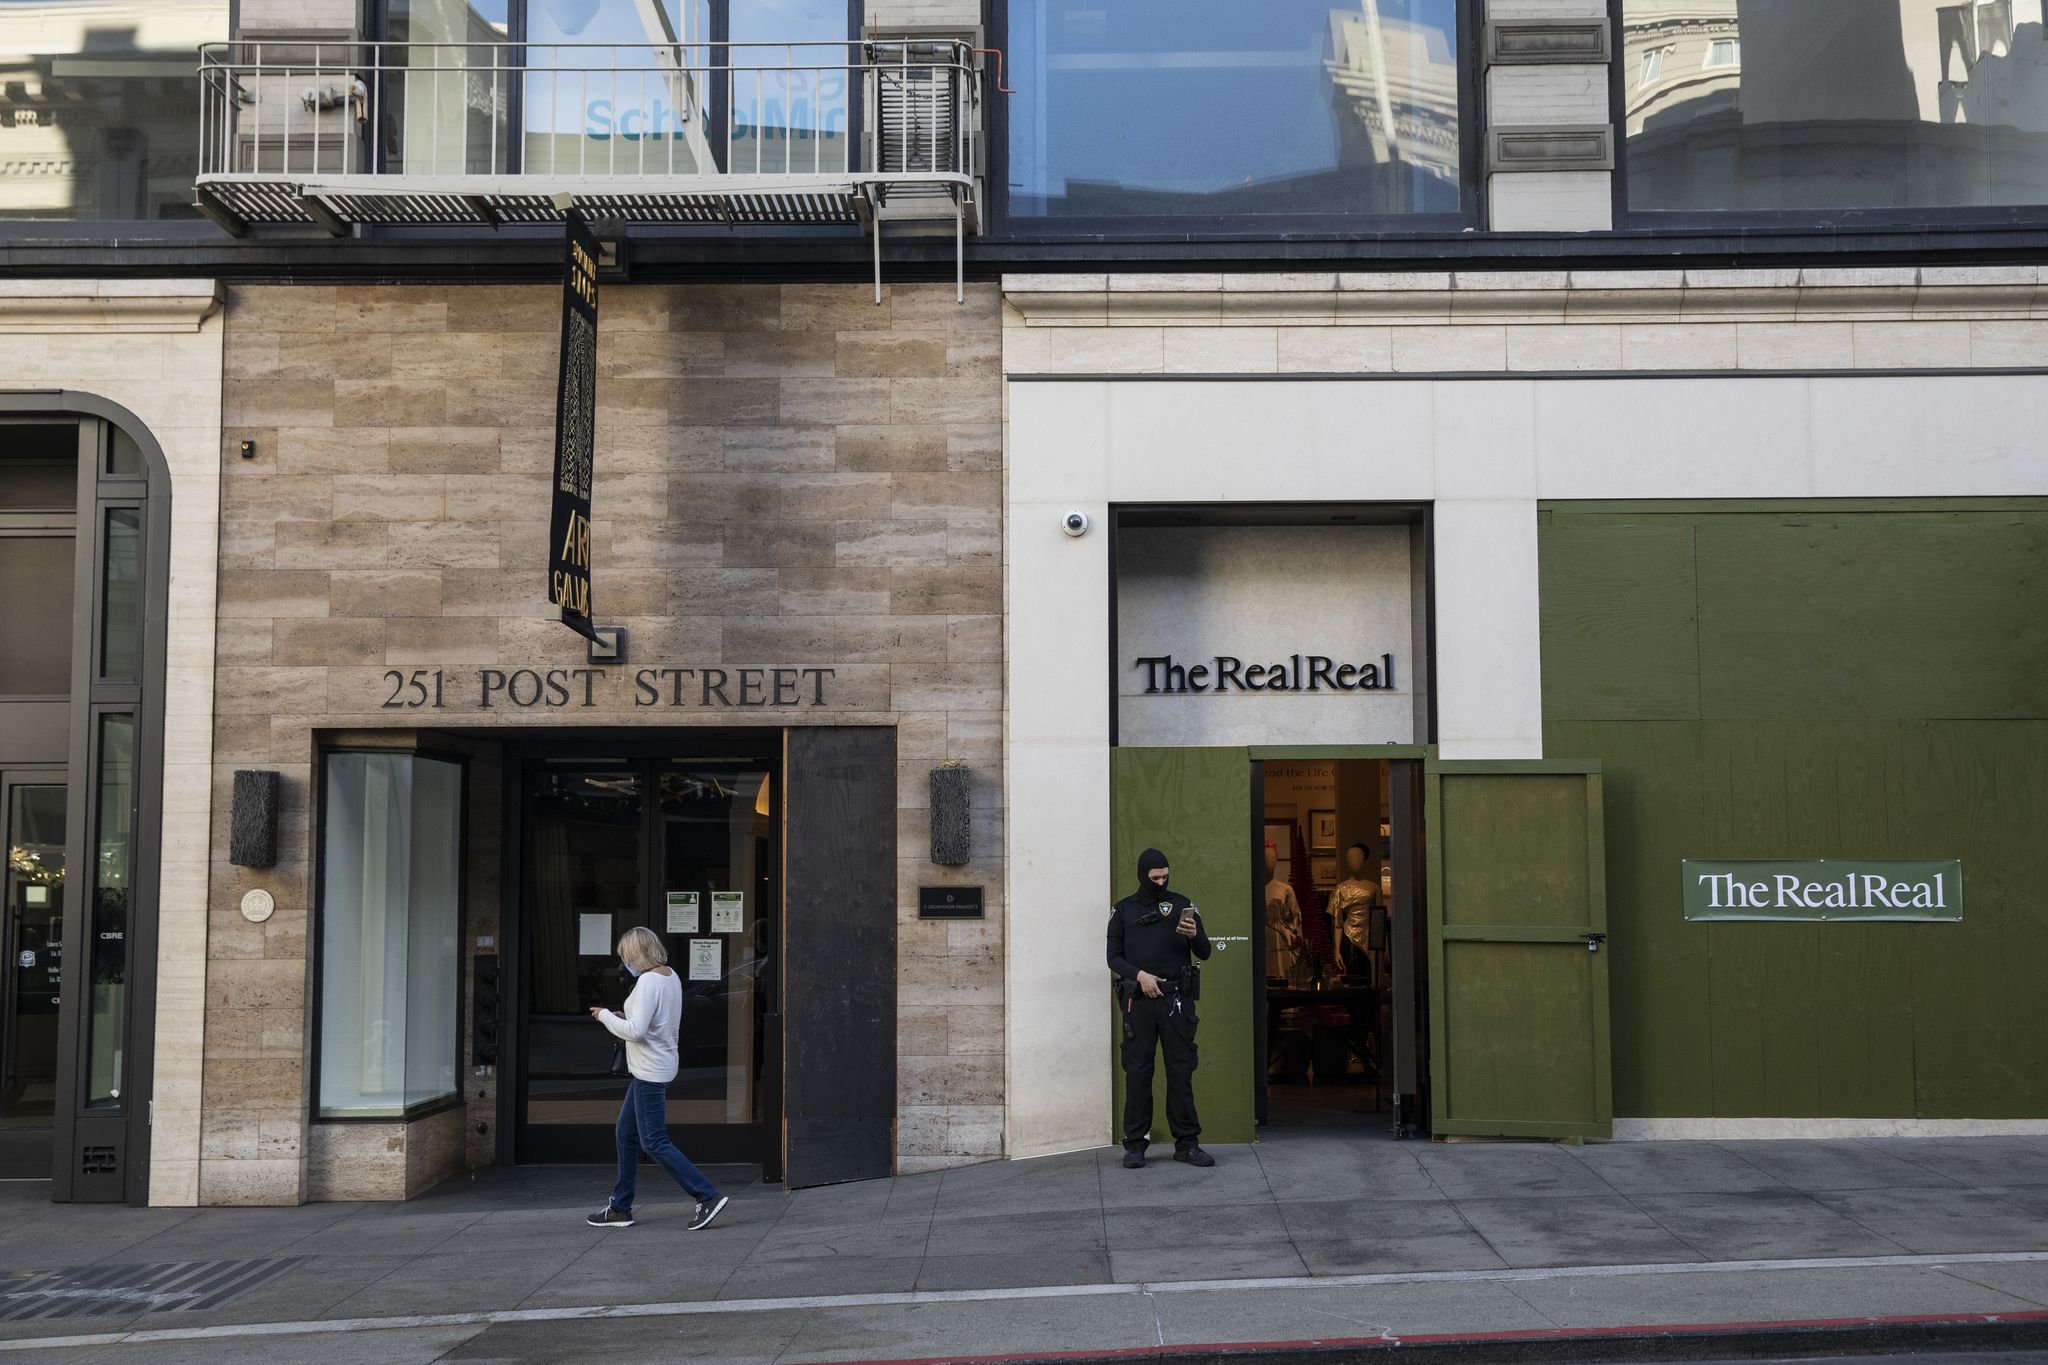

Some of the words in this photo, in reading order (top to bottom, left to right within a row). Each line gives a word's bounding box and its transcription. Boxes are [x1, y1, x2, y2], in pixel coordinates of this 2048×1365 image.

[382, 670, 445, 709] 251
[478, 669, 606, 707] POST
[635, 668, 836, 707] STREET
